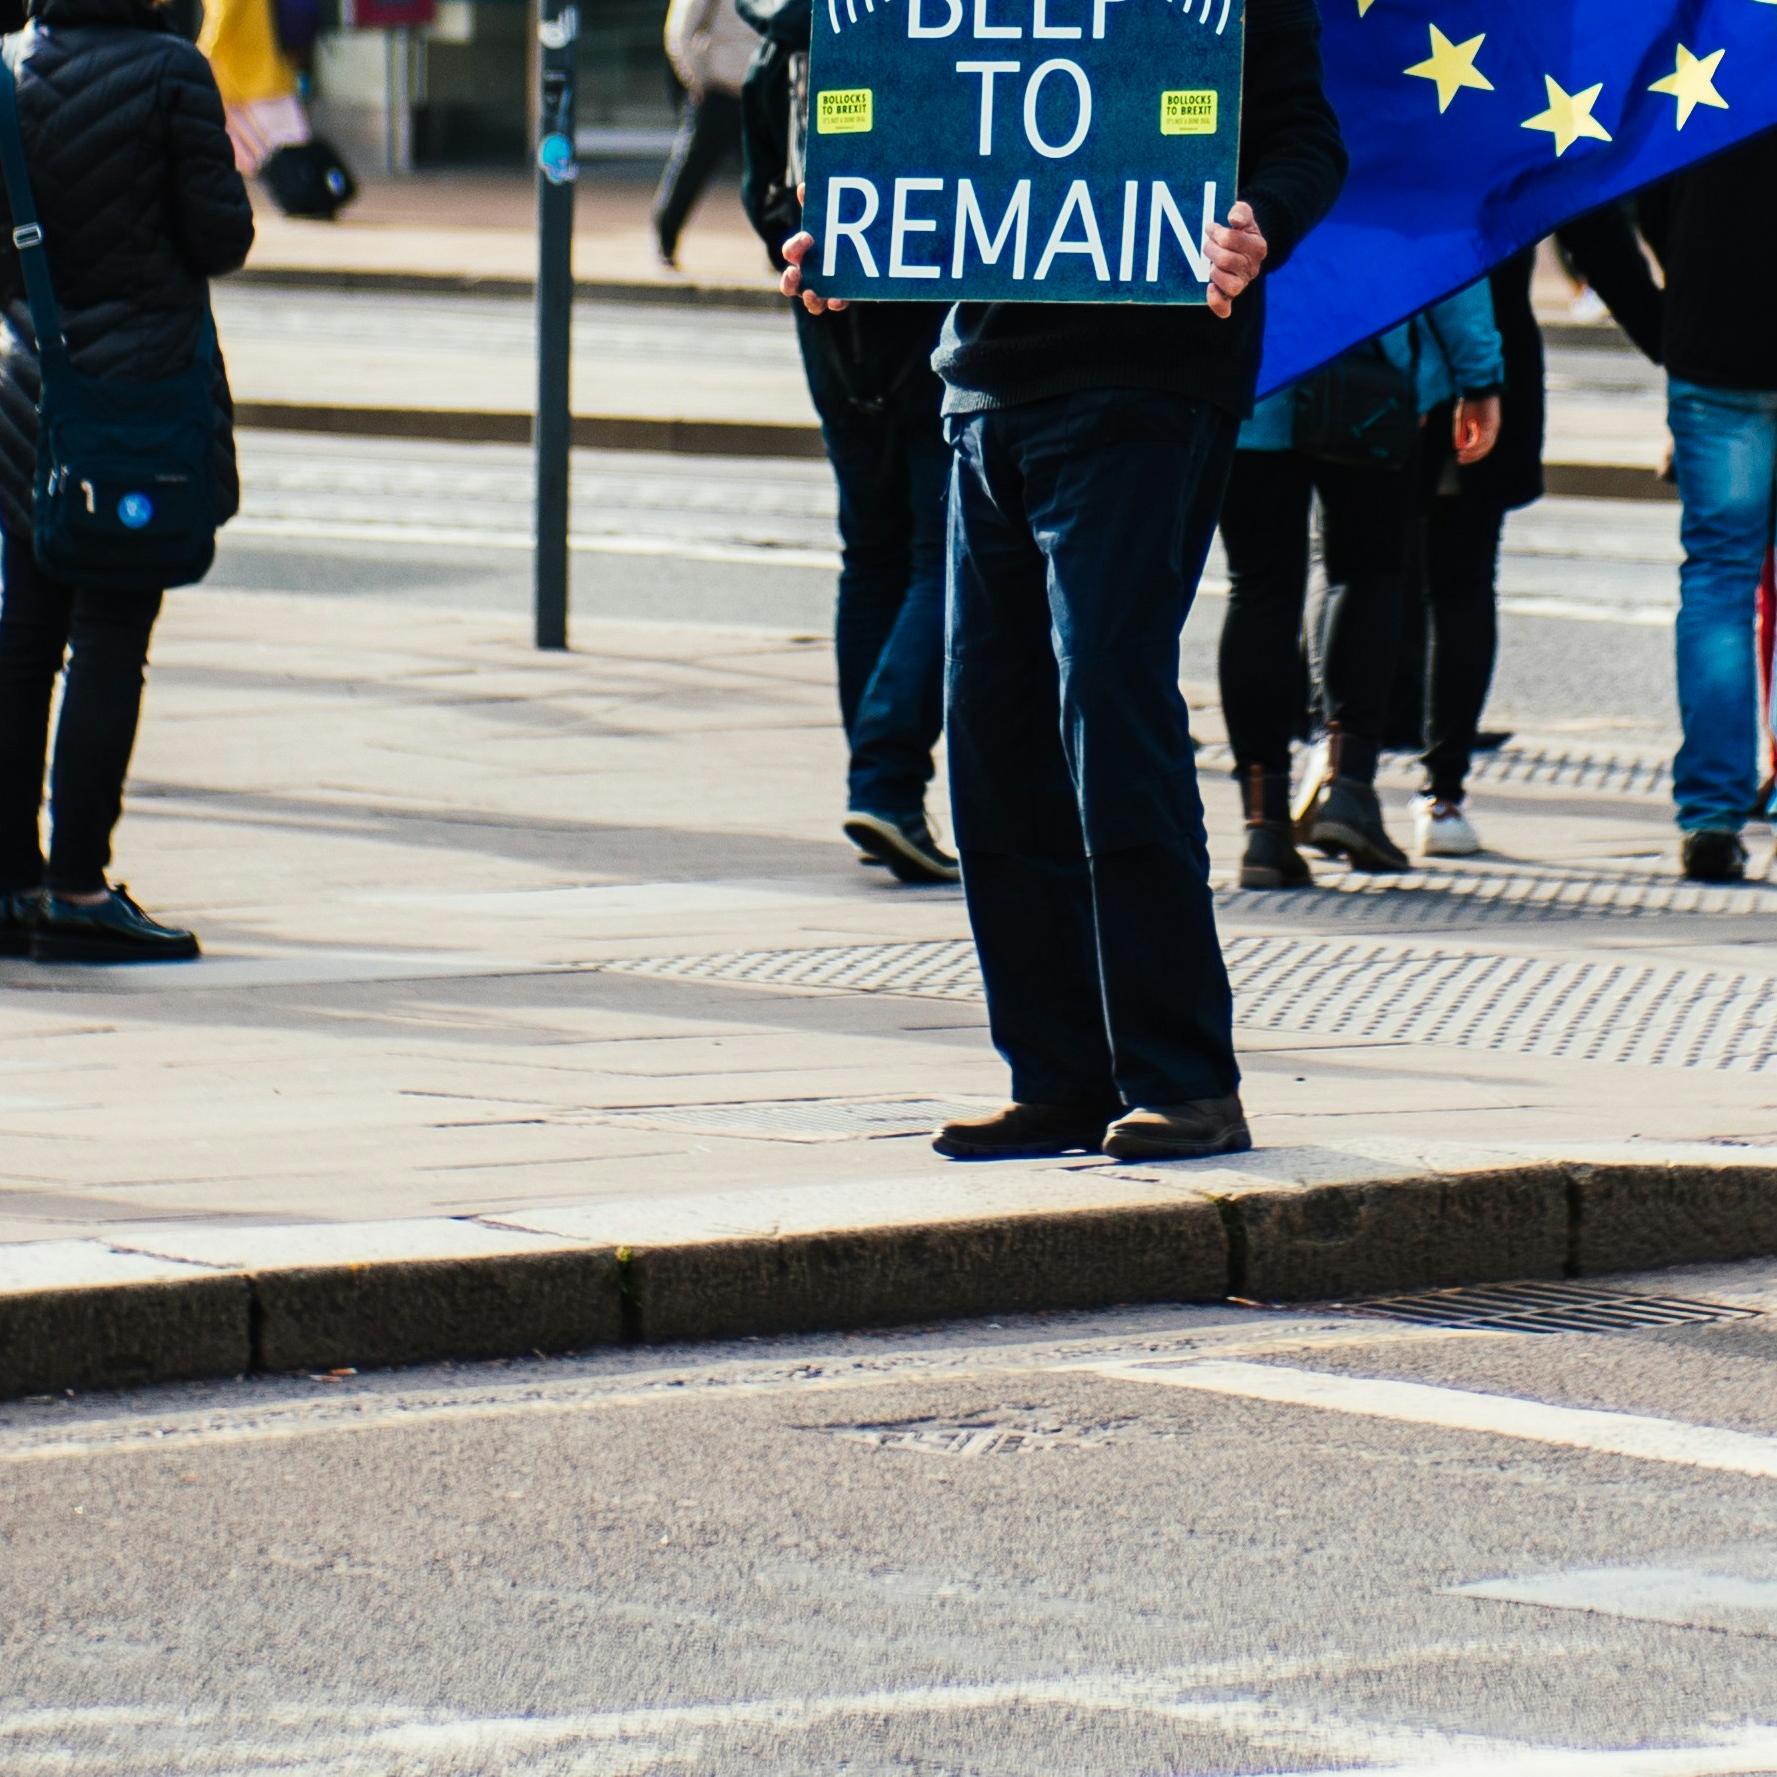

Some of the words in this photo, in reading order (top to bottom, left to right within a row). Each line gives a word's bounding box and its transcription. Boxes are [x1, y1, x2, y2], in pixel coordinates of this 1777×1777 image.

[823, 93, 866, 105] BOLLOCKS
[1167, 95, 1212, 105] BOLLOCKS
[823, 105, 833, 115] TO
[836, 103, 867, 114] BREXIT
[956, 58, 1093, 159] TO
[1166, 105, 1178, 115] TO
[1180, 105, 1212, 115] BREXIT
[822, 176, 1217, 283] REMAIN
